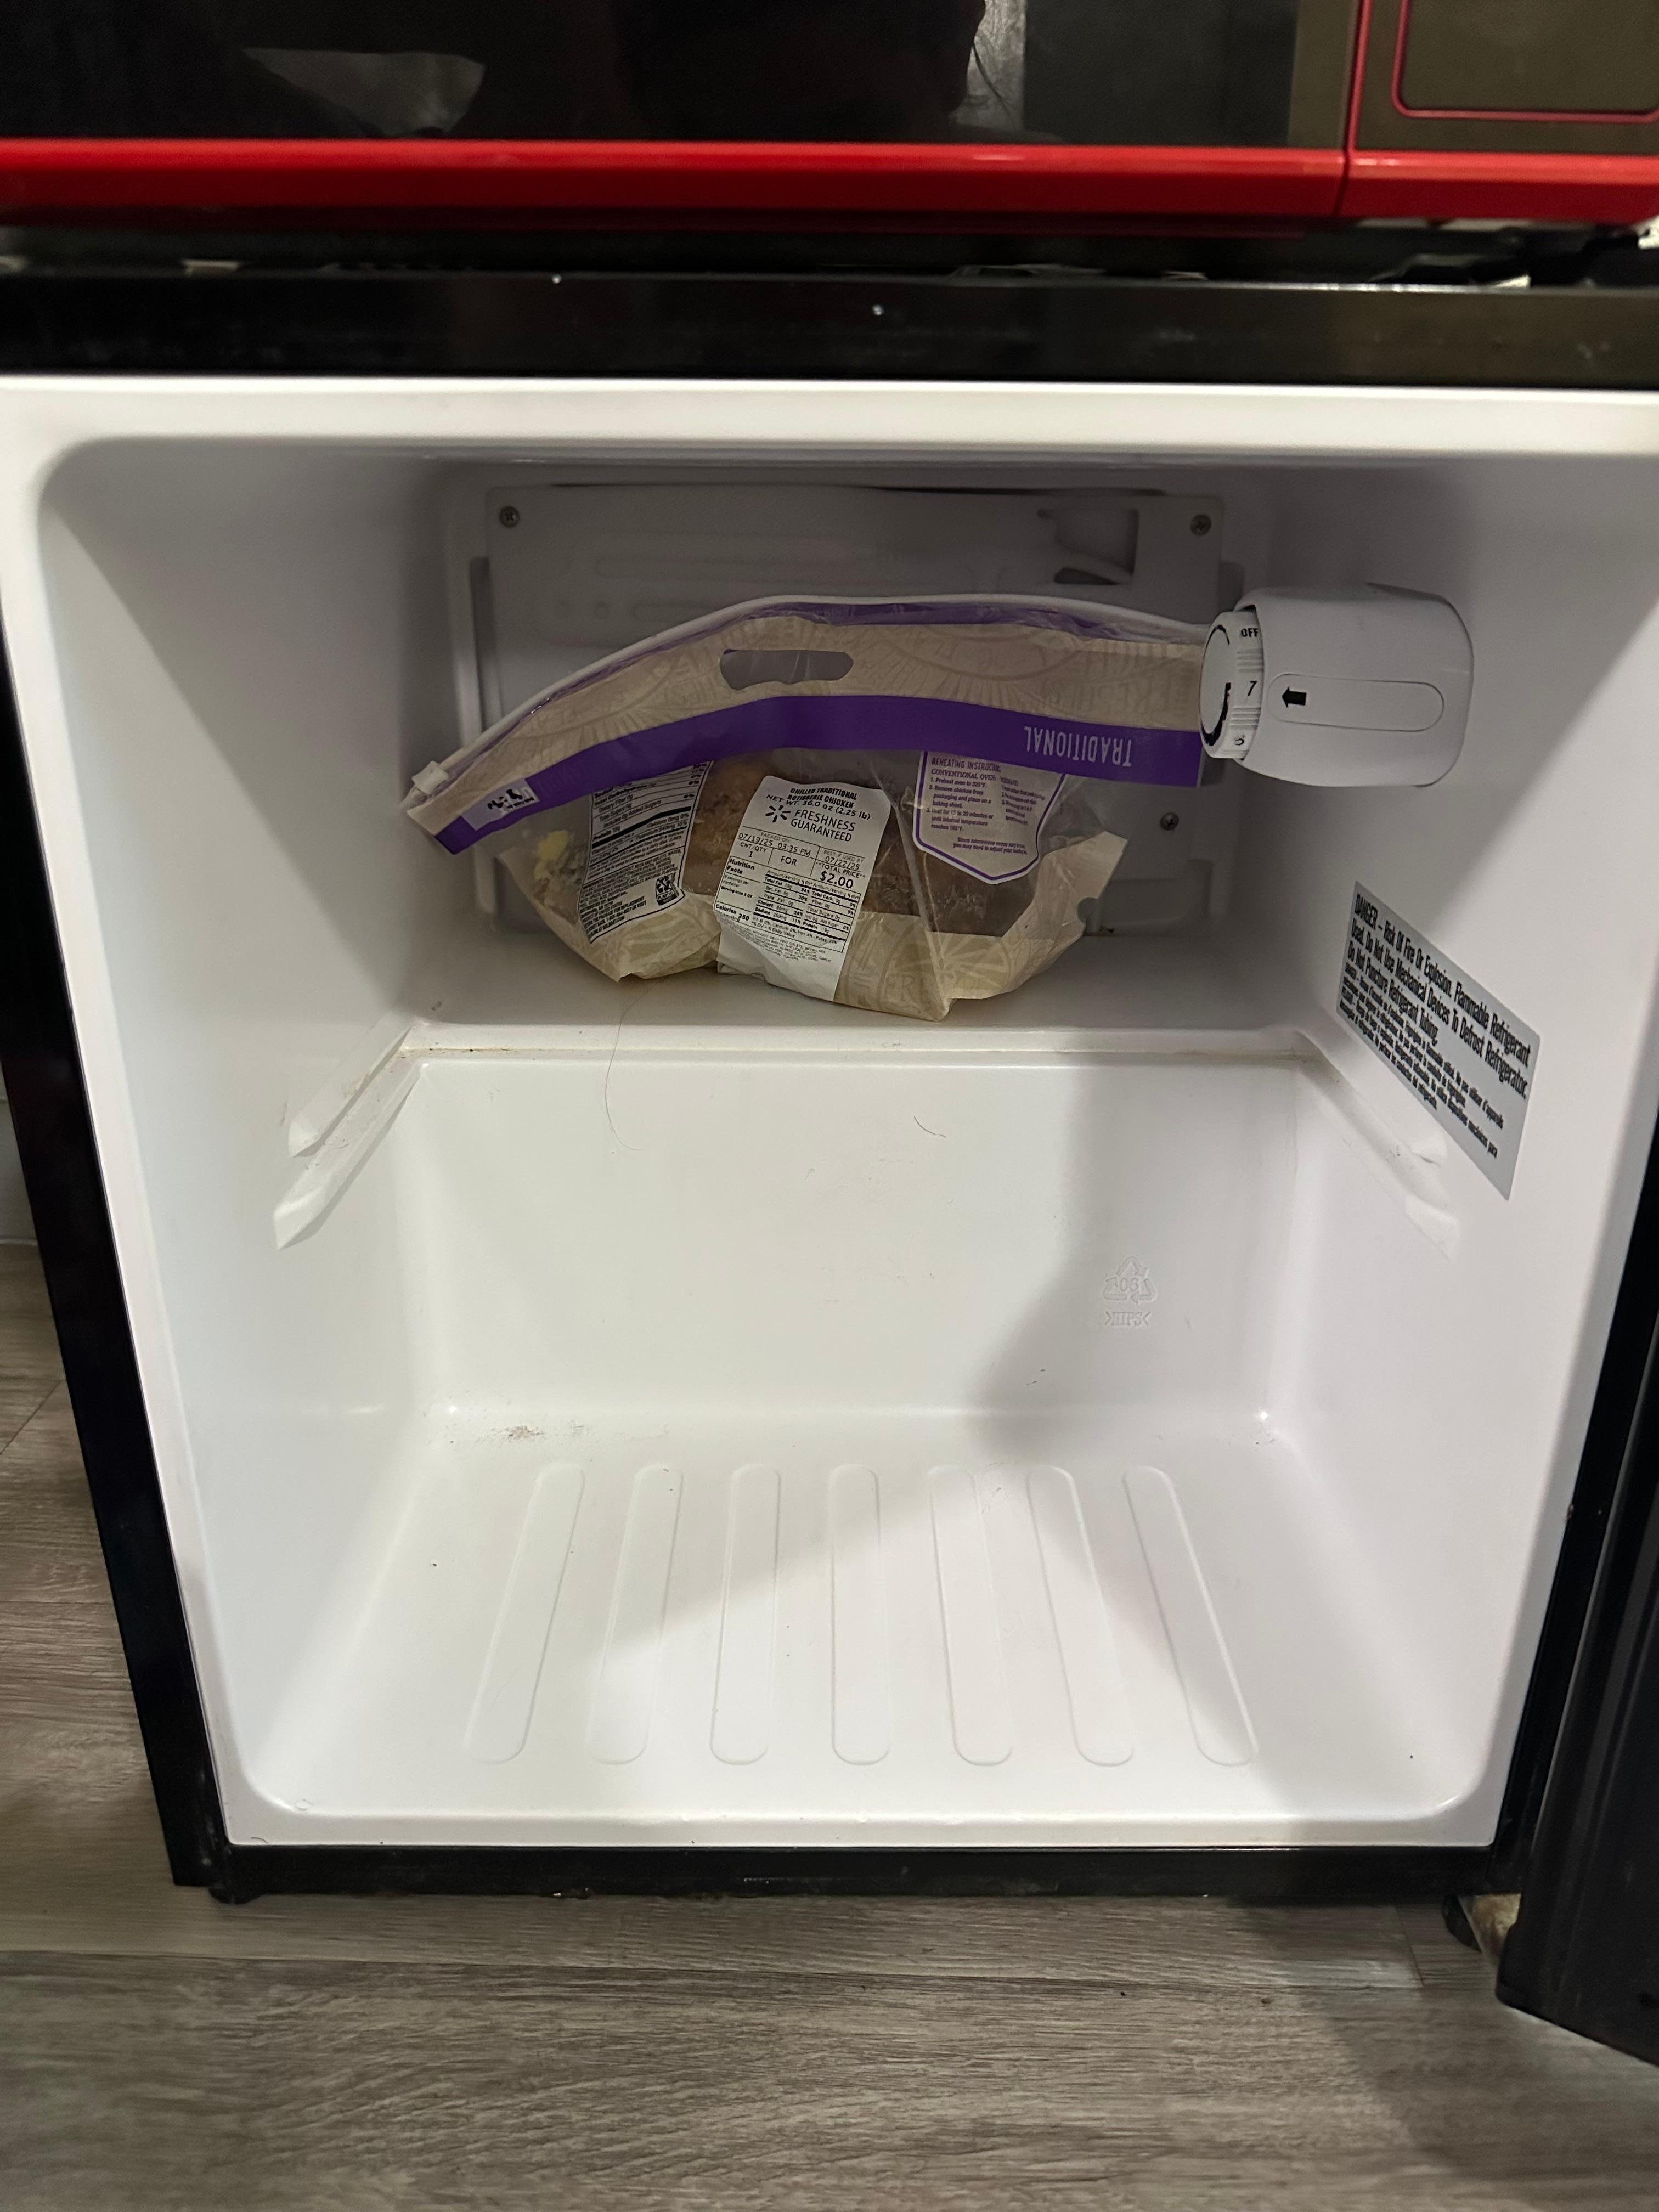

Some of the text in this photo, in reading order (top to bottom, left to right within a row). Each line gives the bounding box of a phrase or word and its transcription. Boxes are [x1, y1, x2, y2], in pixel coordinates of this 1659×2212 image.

[1241, 628, 1258, 637] OFF
[1248, 680, 1257, 696] 7
[1024, 726, 1132, 767] TRADITIONAL
[931, 757, 965, 769] REHEATING
[931, 769, 978, 779] CONVENTIONAL
[817, 787, 857, 800] TRADITIONAL
[766, 794, 785, 803] NET
[836, 806, 857, 816] (2.25
[858, 811, 871, 820] lb)
[824, 795, 854, 809] CHICKEN
[795, 809, 856, 832] FRESHNESS
[791, 819, 852, 842] GUARANTEED
[738, 833, 773, 846] 07/19/25
[800, 848, 811, 856] PM
[740, 842, 767, 853] CNT/QTY
[729, 858, 755, 870] Nutrition
[780, 855, 797, 866] FOR
[825, 856, 860, 870] 07/22/25
[726, 865, 743, 874] Facts
[819, 870, 854, 889] $2.00
[715, 904, 737, 914] Calories
[738, 913, 750, 921] 250
[803, 922, 818, 930] Protein
[1355, 892, 1379, 932] DANGER
[1383, 917, 1397, 948] Risk
[1396, 928, 1405, 954] Of
[1403, 936, 1416, 964] Fire
[1415, 948, 1424, 970] Or
[1424, 955, 1452, 998] Explosion.
[1454, 981, 1489, 1030] Flammable
[1490, 1013, 1531, 1068] Refrigerant
[1347, 938, 1357, 962] Do
[1355, 945, 1367, 973] Not
[1365, 955, 1389, 994] Puncture
[1388, 978, 1418, 1024] Refrigerant
[1419, 1007, 1438, 1046] Tubing.
[1365, 928, 1375, 955] Do
[1373, 935, 1385, 964] Not
[1383, 946, 1396, 975] Use
[1395, 957, 1427, 1003] Mechanical
[1427, 987, 1450, 1025] Devices
[1452, 1008, 1459, 1034] To
[1459, 1017, 1485, 1058] Defrost
[1485, 1040, 1528, 1099] Refrigerator.
